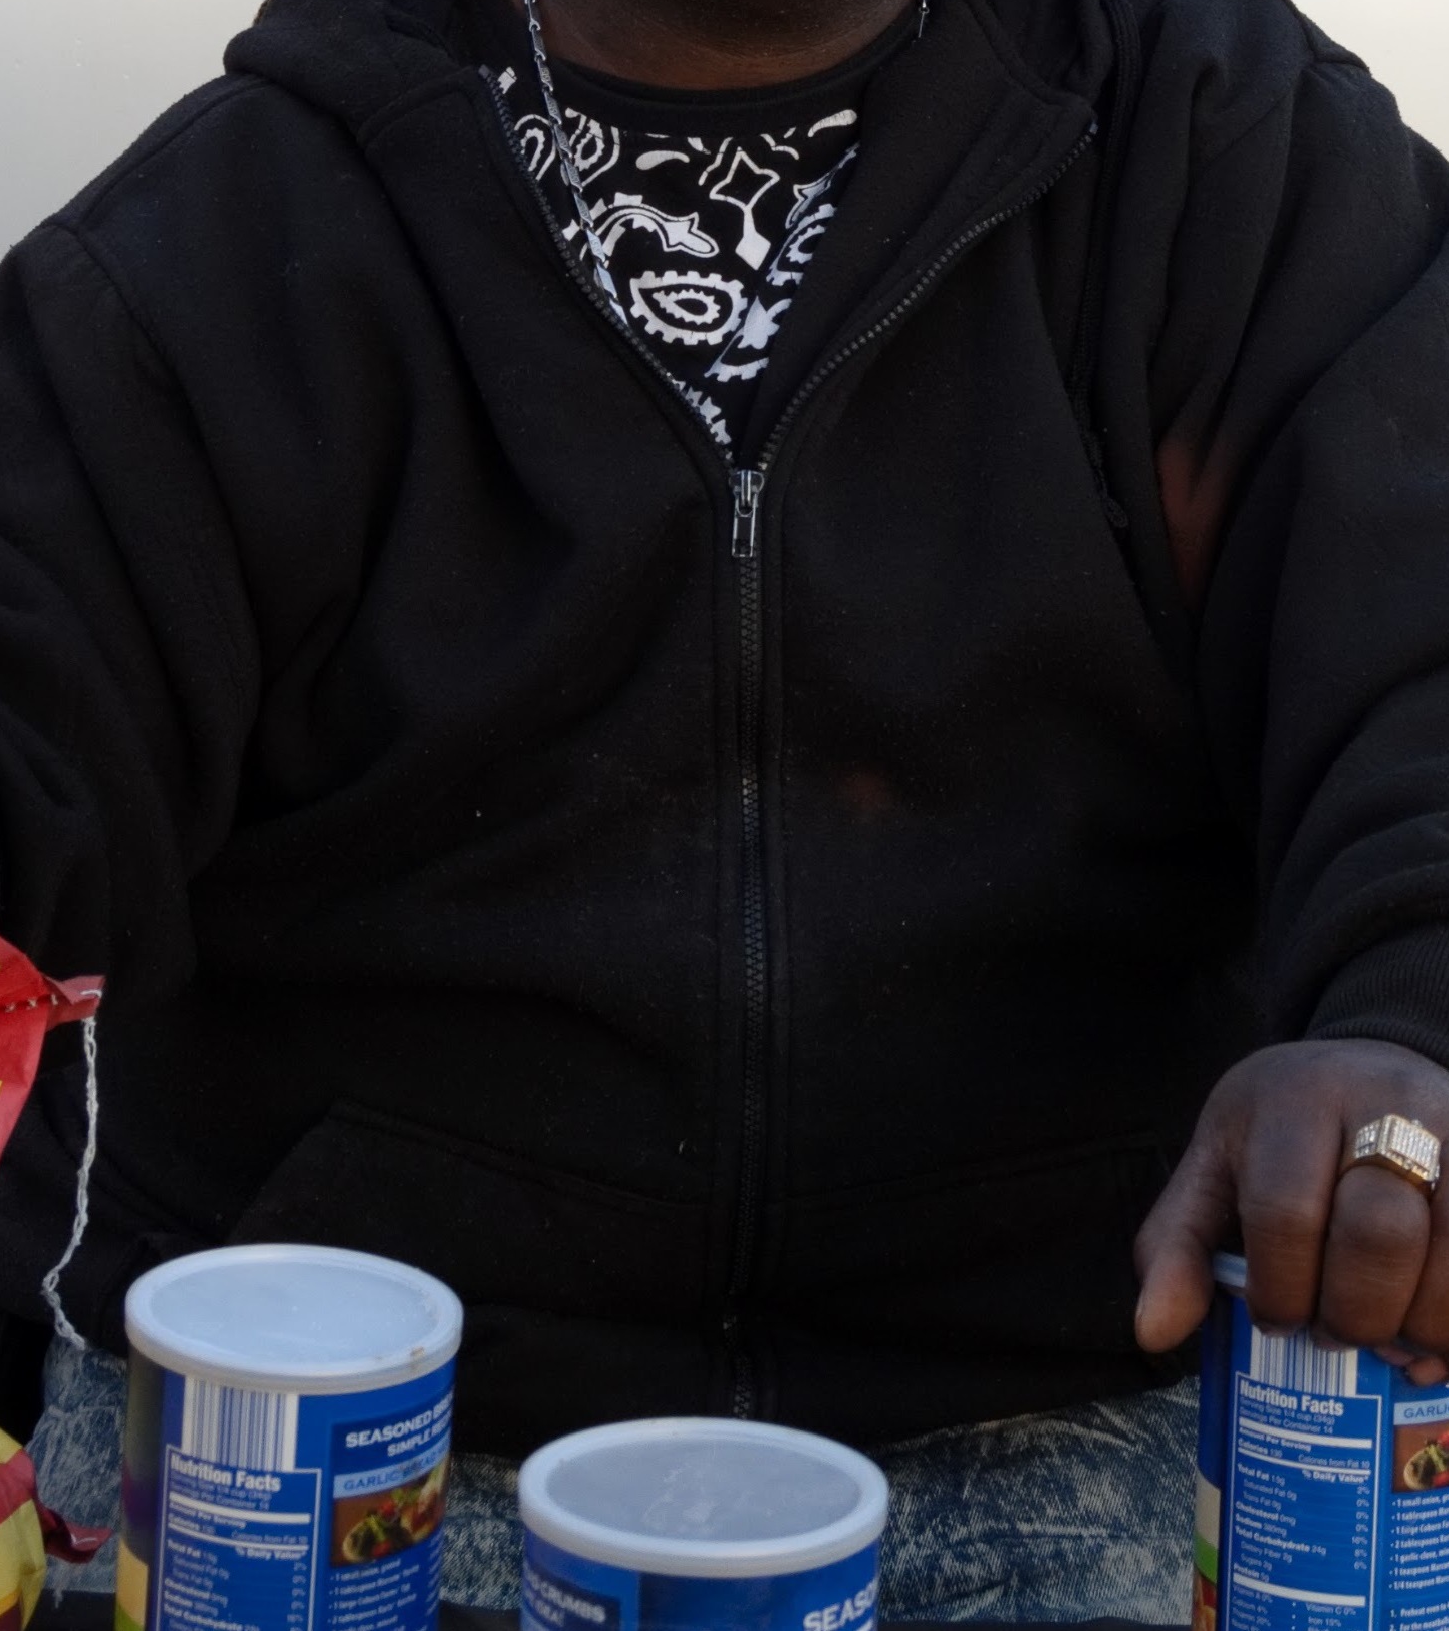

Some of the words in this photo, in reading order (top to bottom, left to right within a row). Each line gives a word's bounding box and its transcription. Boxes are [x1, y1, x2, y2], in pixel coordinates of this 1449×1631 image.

[1240, 1379, 1298, 1409] Nutrition
[1302, 1394, 1344, 1416] Facts
[345, 1409, 432, 1448] SEASONED
[387, 1425, 431, 1457] SIMPLE
[171, 1454, 232, 1487] Nutrition
[235, 1471, 281, 1492] Facts
[344, 1469, 401, 1491] GARLIC
